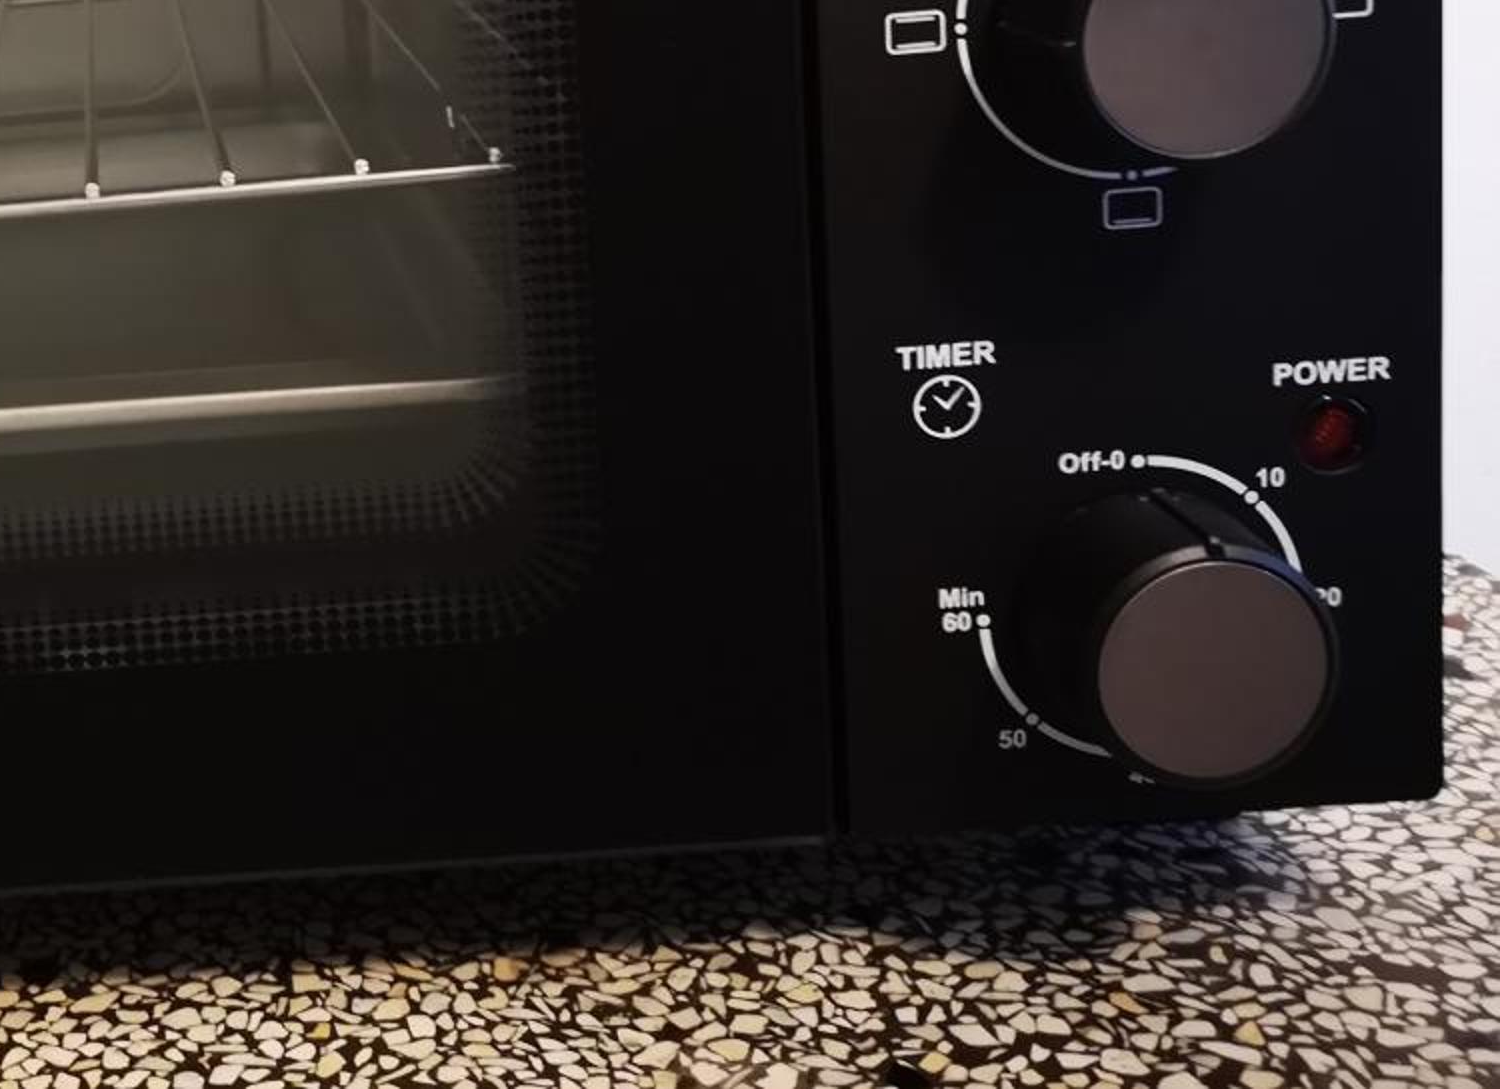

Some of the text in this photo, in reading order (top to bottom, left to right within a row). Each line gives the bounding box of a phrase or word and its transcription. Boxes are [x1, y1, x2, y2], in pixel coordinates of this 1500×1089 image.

[896, 340, 997, 371] TIMER
[1273, 356, 1391, 387] POWER
[1058, 450, 1126, 474] Off-0
[1255, 467, 1286, 489] 10
[938, 587, 985, 610] Min
[942, 611, 972, 632] 60
[998, 728, 1028, 750] 50
